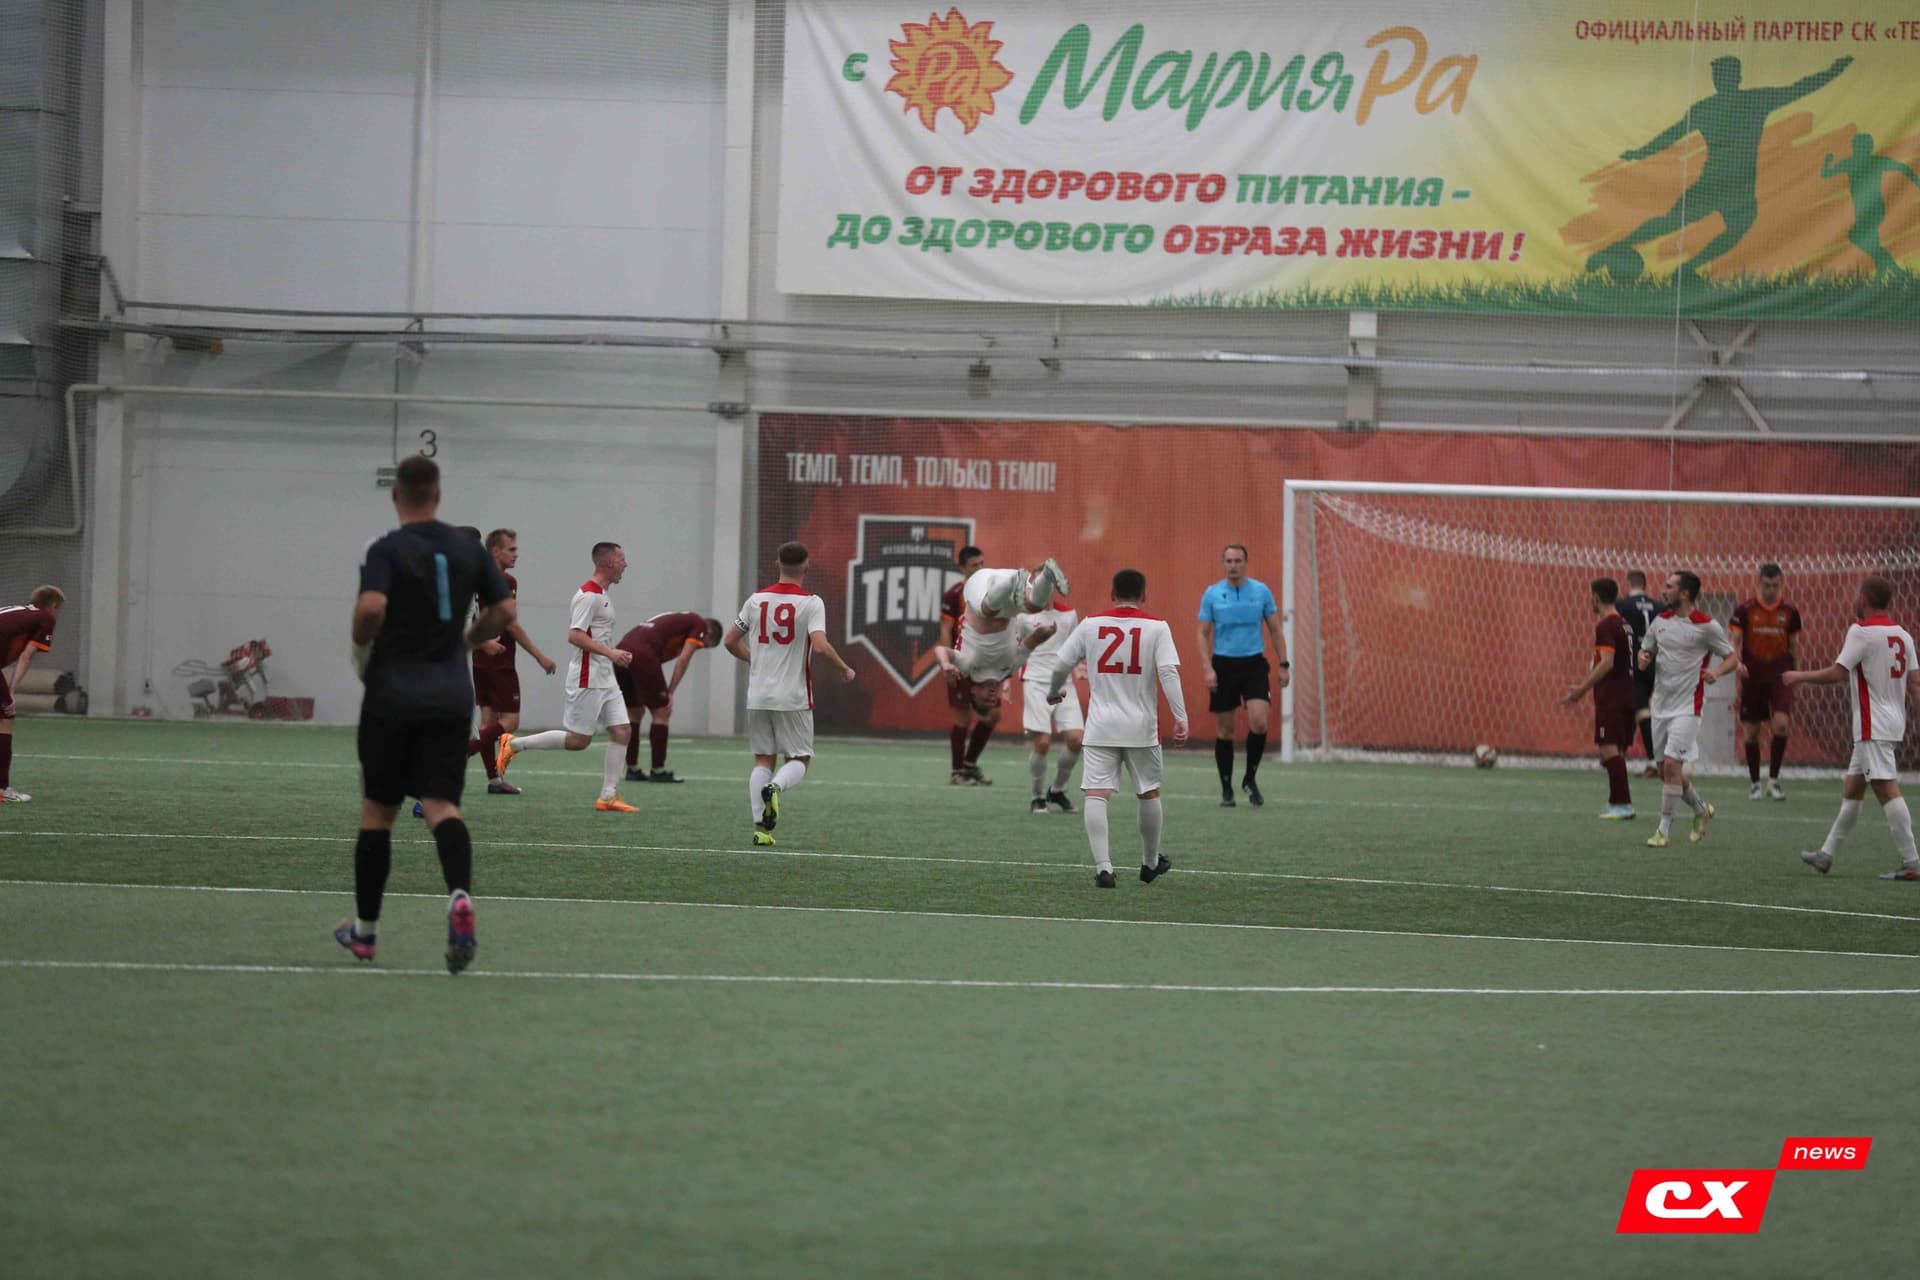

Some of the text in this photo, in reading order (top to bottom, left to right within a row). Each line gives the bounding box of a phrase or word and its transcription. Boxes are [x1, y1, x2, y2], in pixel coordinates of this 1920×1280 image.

[1575, 16, 1746, 45] ОФИЦИАЛЬНЫЙ
[1753, 20, 1843, 41] ПАРТНЕР
[1851, 21, 1877, 40] СК
[905, 166, 963, 196] ОТ
[968, 168, 1226, 204] ЗДОРОВОГО
[1236, 174, 1444, 207] ПИТАНИЯ
[826, 213, 892, 249] ДО
[898, 217, 1155, 254] ЗДОРОВОГО
[1163, 225, 1327, 257] ОБРАЗА
[420, 429, 438, 458] 3
[786, 452, 1057, 492] ТЕМП, ТЕМП, ТОЛЬКО ТЕМП!
[434, 553, 452, 621] 1
[862, 565, 965, 624] ТЕМ
[758, 601, 796, 645] 19
[1097, 625, 1142, 675] 21
[1887, 635, 1906, 679] 3
